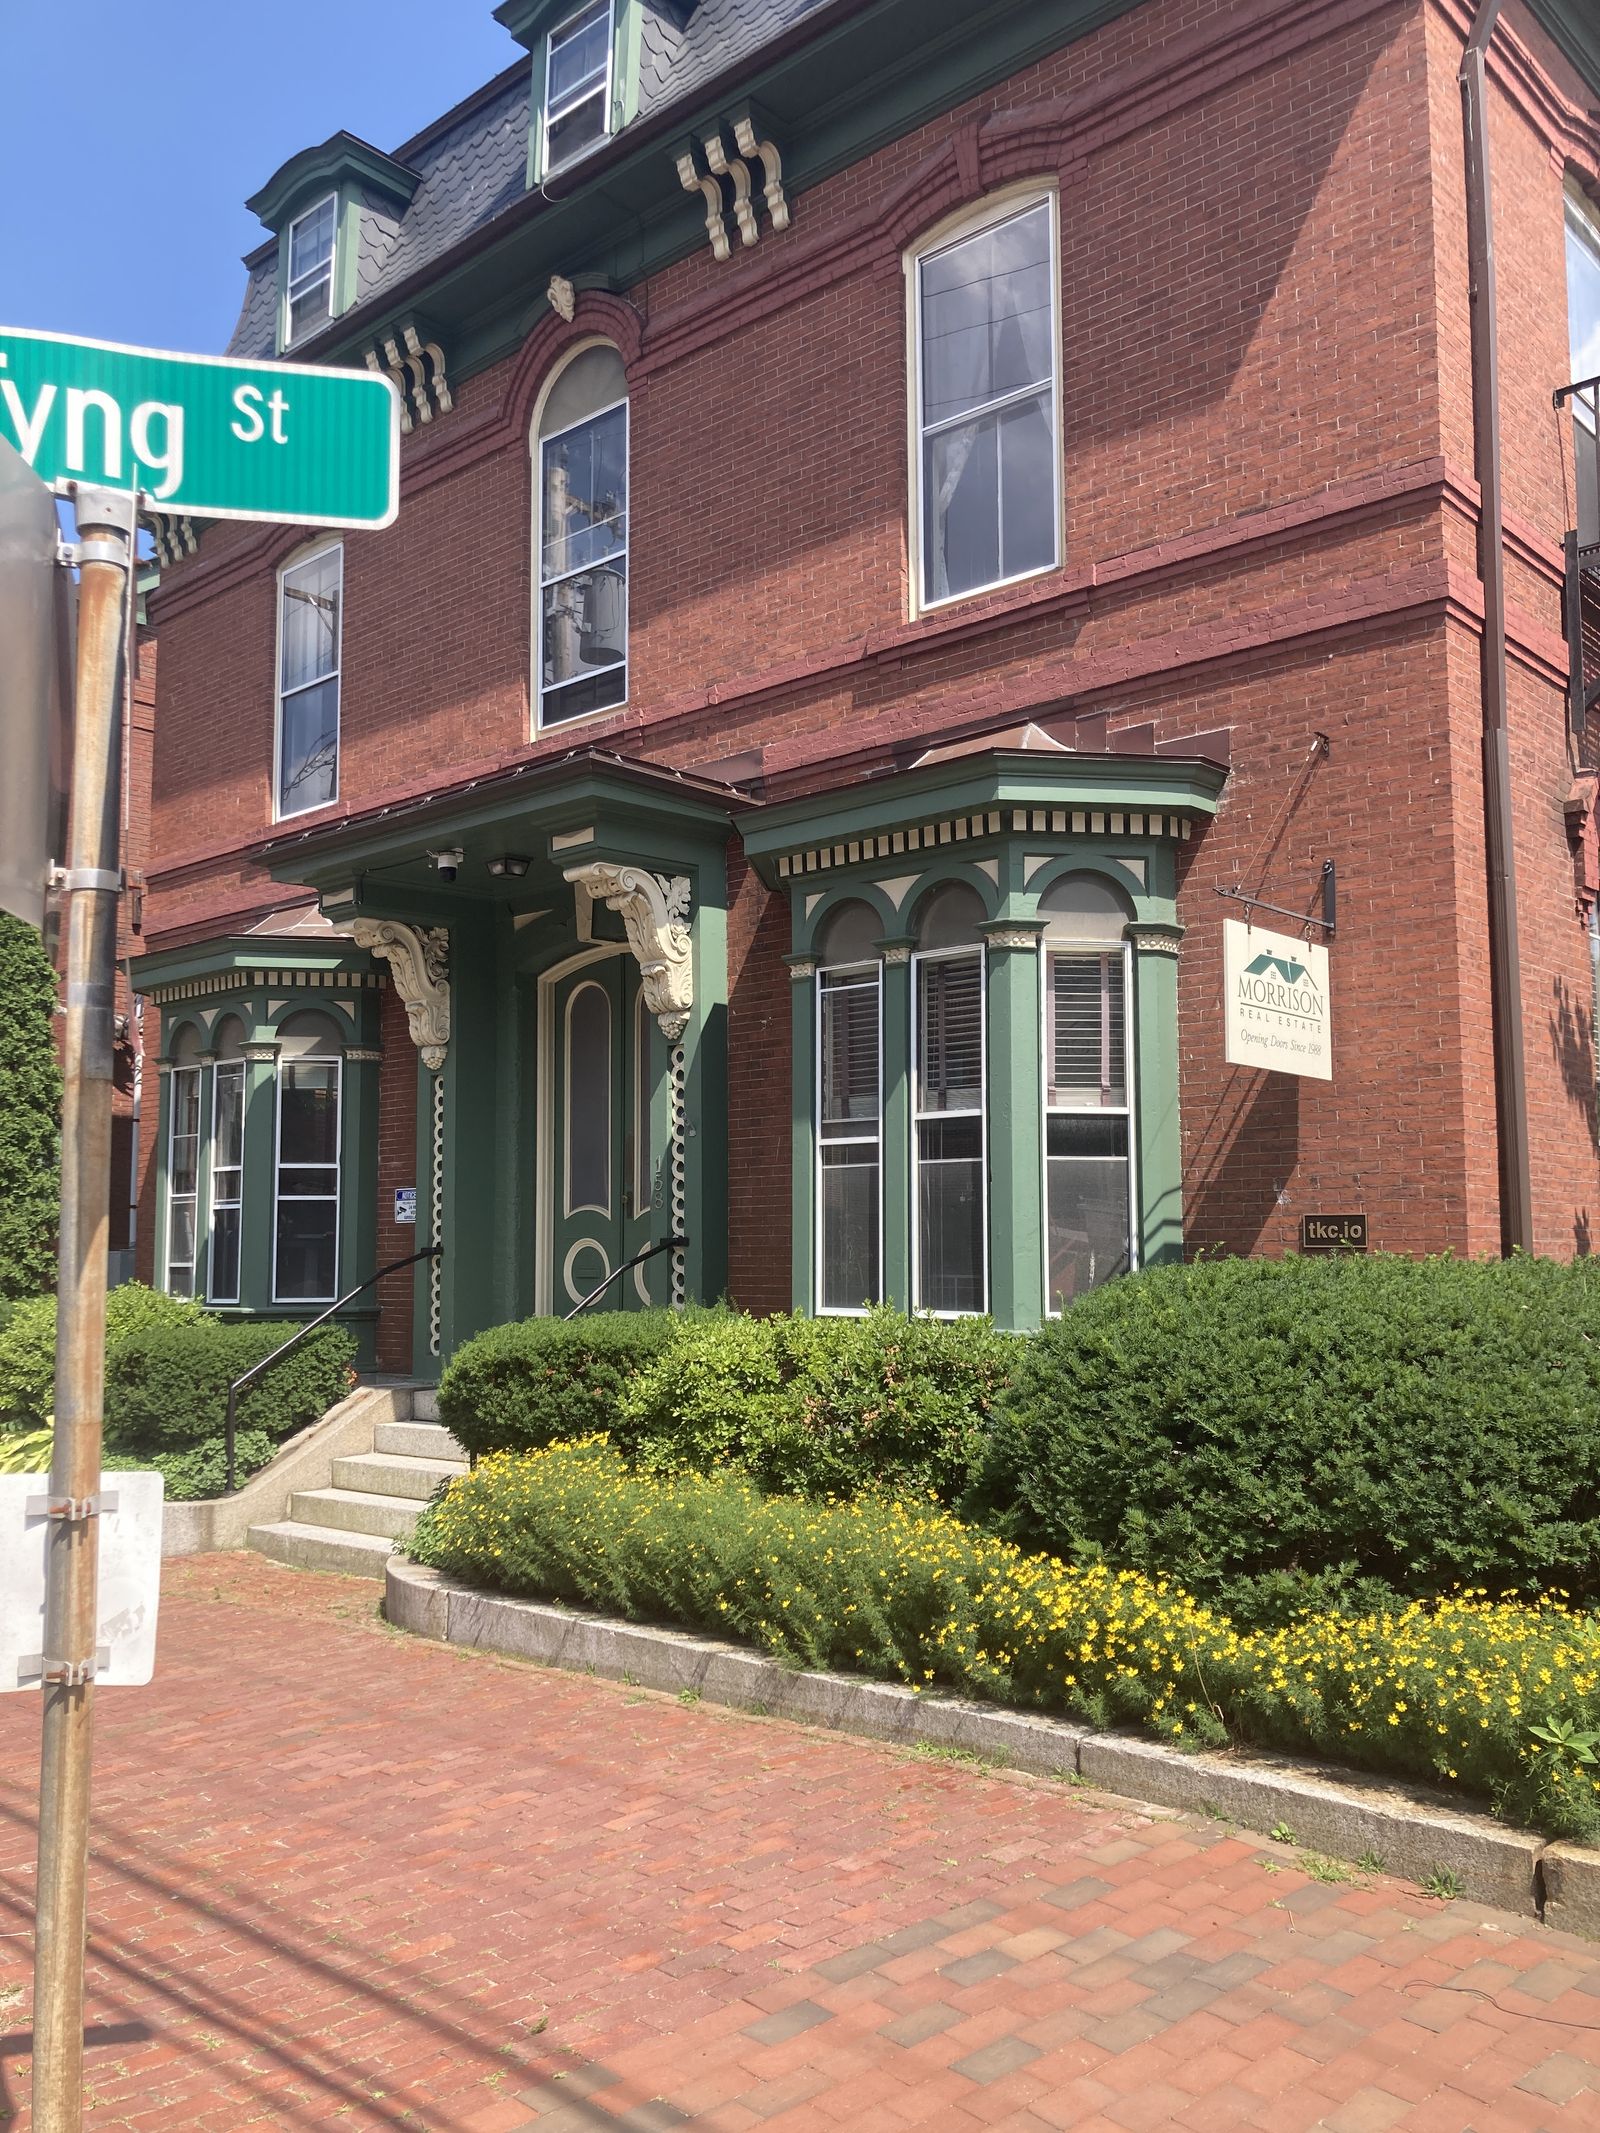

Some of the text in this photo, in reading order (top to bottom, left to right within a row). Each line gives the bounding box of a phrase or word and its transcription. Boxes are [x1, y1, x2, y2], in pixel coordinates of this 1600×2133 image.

[0, 353, 290, 499] yng St
[1238, 975, 1324, 1016] MORRISON
[1240, 1007, 1322, 1034] REAL ESTATE
[1240, 1028, 1269, 1049] Opening
[1270, 1034, 1289, 1050] Doors
[1290, 1039, 1307, 1053] Since
[1308, 1221, 1362, 1239] tkc.io
